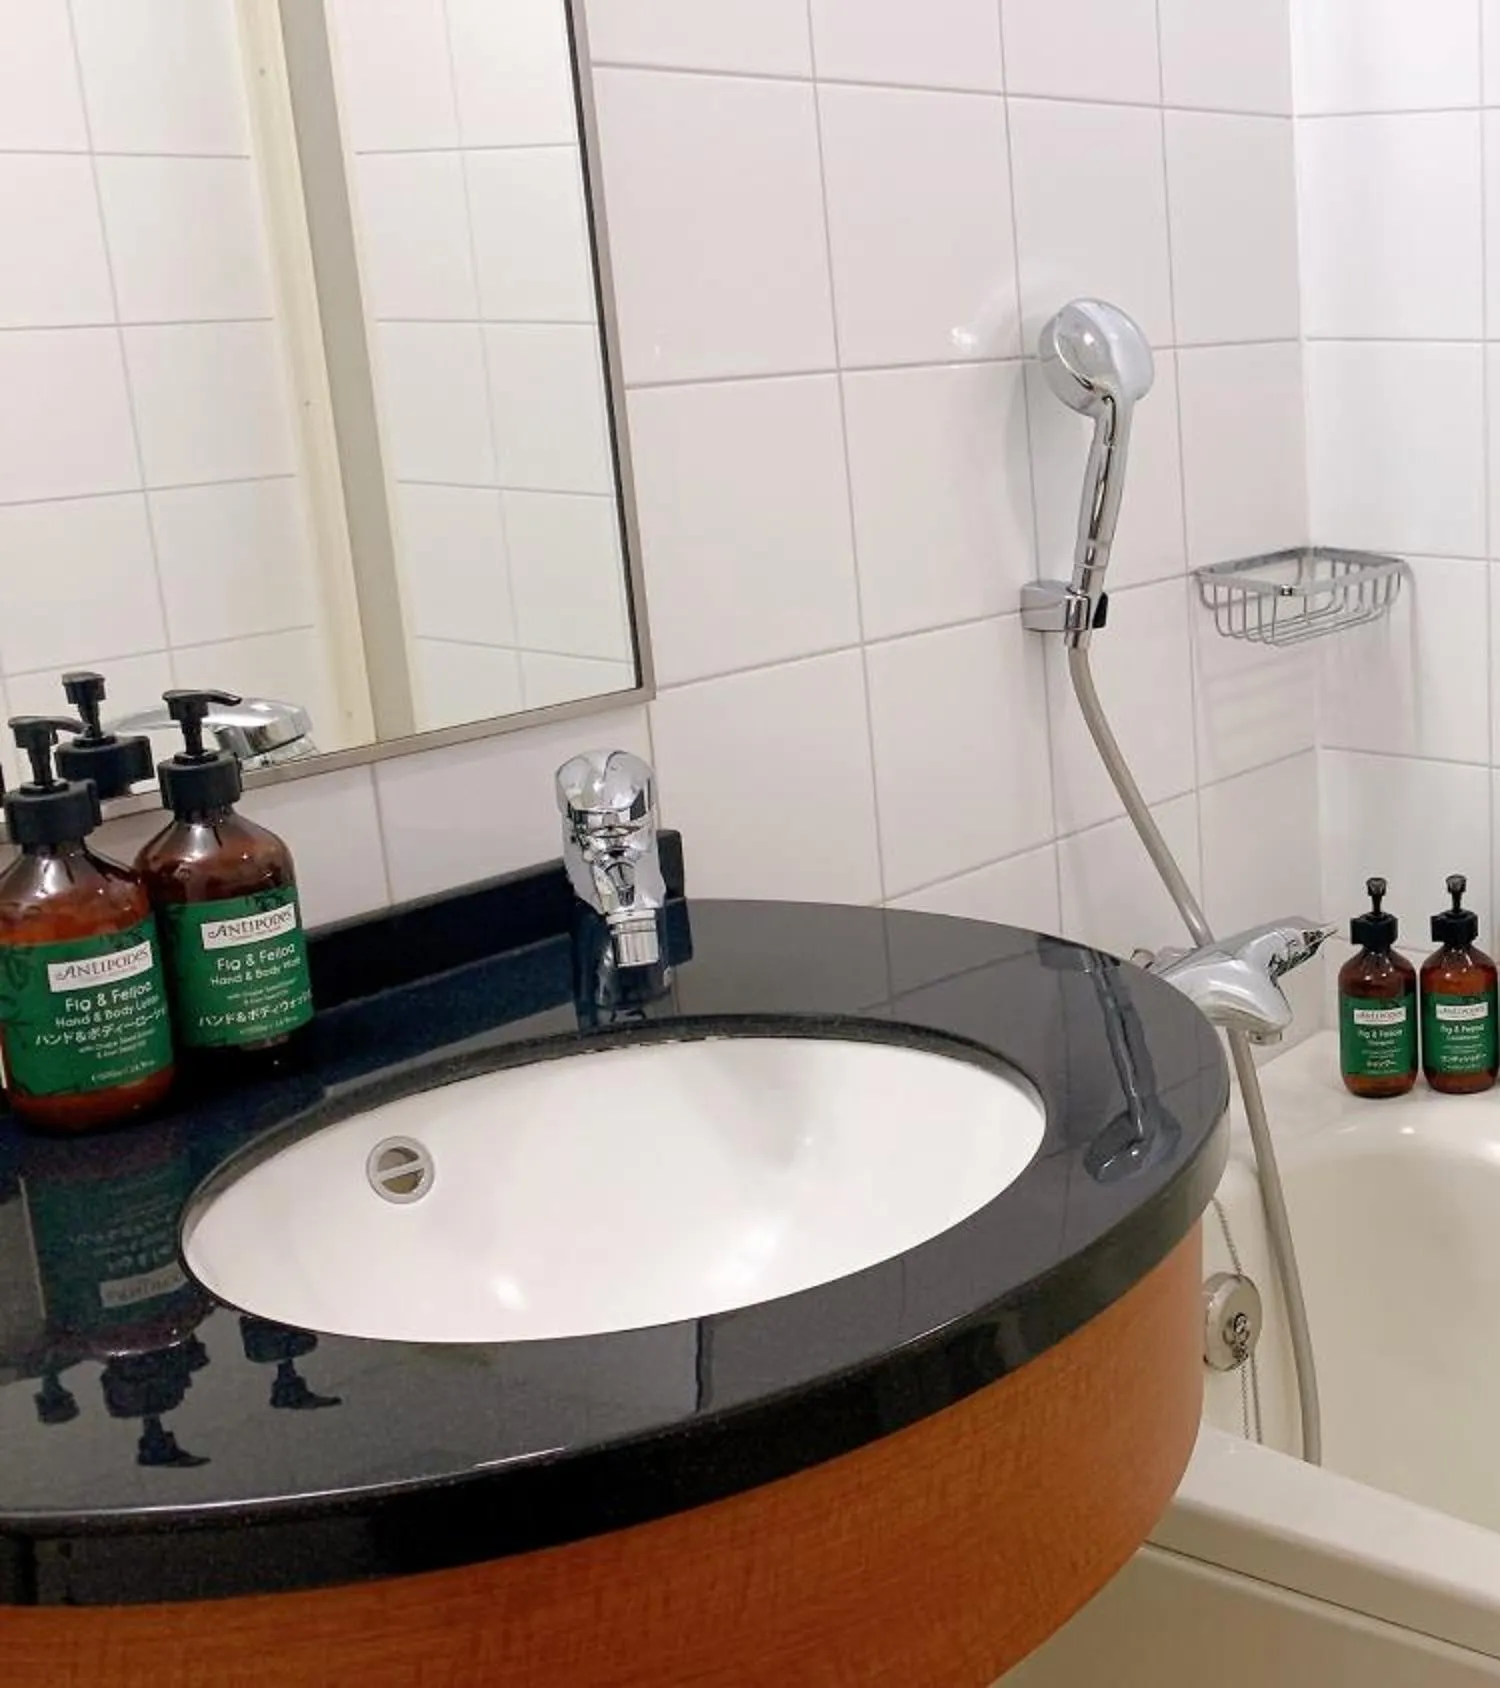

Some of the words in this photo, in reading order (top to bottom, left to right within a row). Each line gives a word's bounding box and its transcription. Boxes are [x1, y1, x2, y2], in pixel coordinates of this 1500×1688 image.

[245, 953, 255, 967] &
[210, 975, 243, 986] Hand
[245, 970, 253, 981] &
[97, 993, 107, 1007] &
[55, 1013, 91, 1029] Hand
[93, 1011, 102, 1023] &
[105, 1004, 134, 1020] Body
